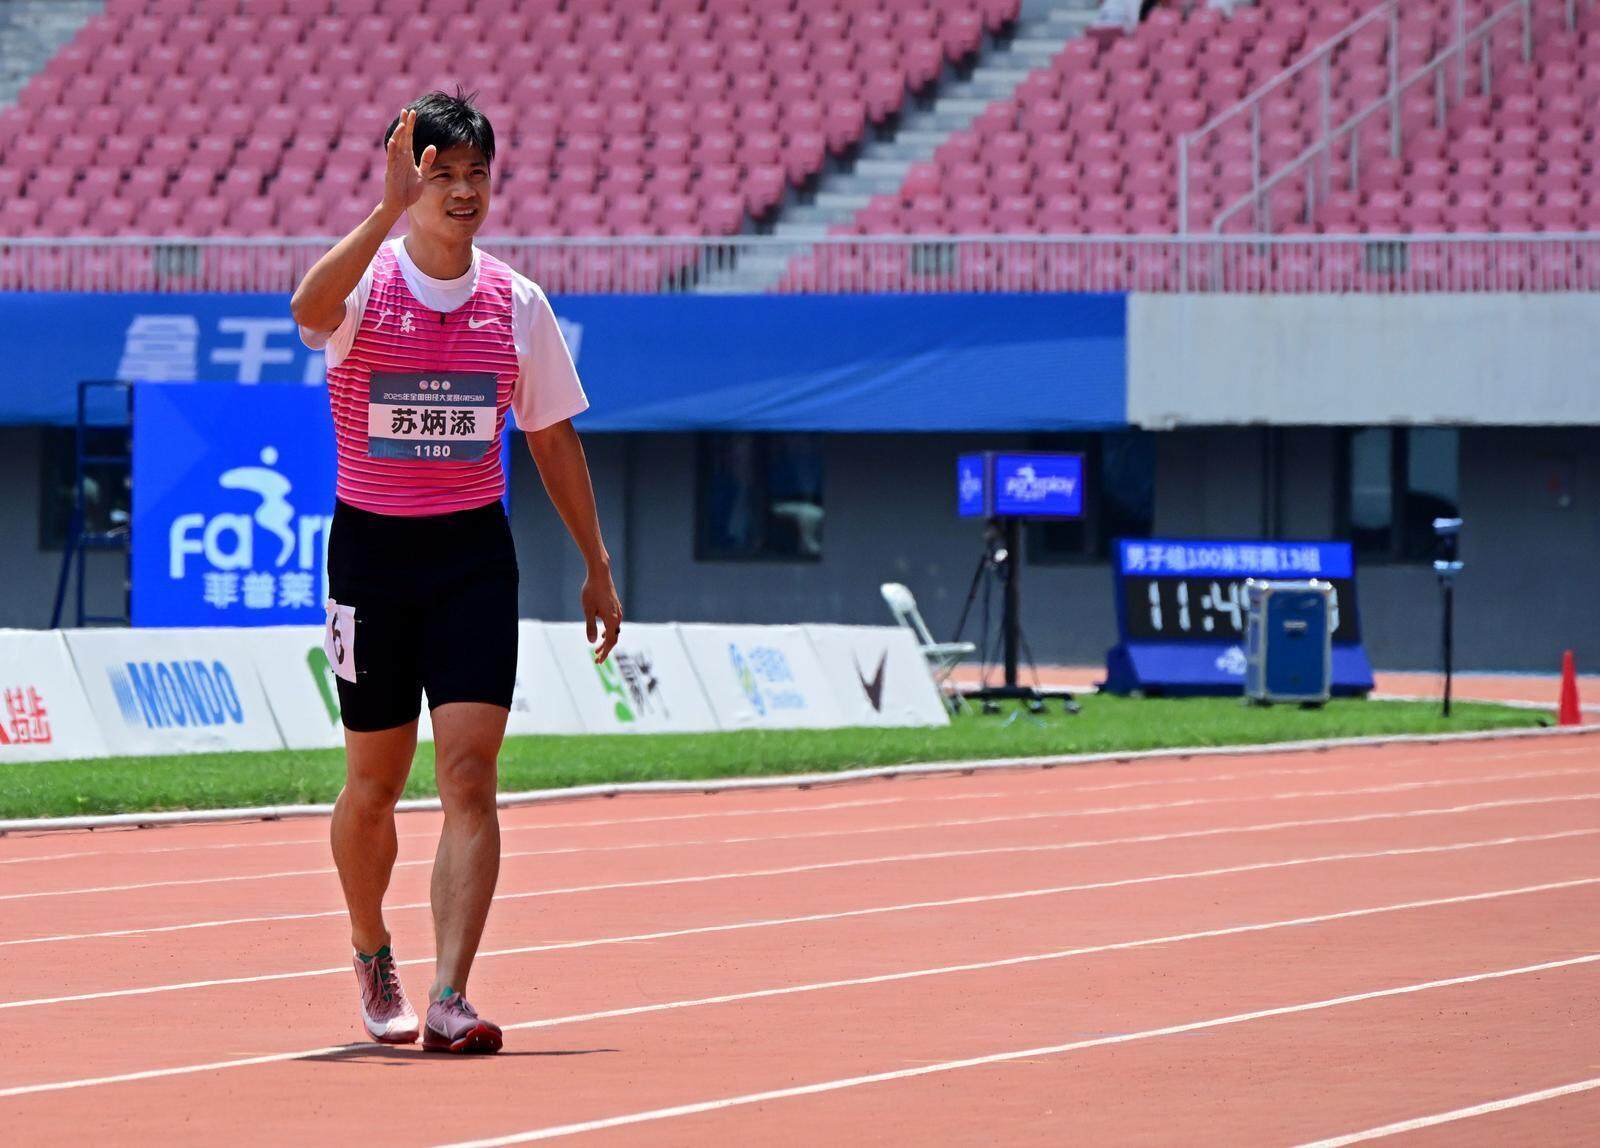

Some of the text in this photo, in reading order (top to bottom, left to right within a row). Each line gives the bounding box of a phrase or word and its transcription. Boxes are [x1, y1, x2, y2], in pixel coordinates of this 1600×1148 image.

[374, 308, 416, 333] 广东
[391, 408, 476, 436] 苏炳添
[414, 445, 451, 457] 1180
[203, 571, 315, 609] 菲普莱
[332, 612, 345, 665] 6
[126, 660, 244, 729] MONDO
